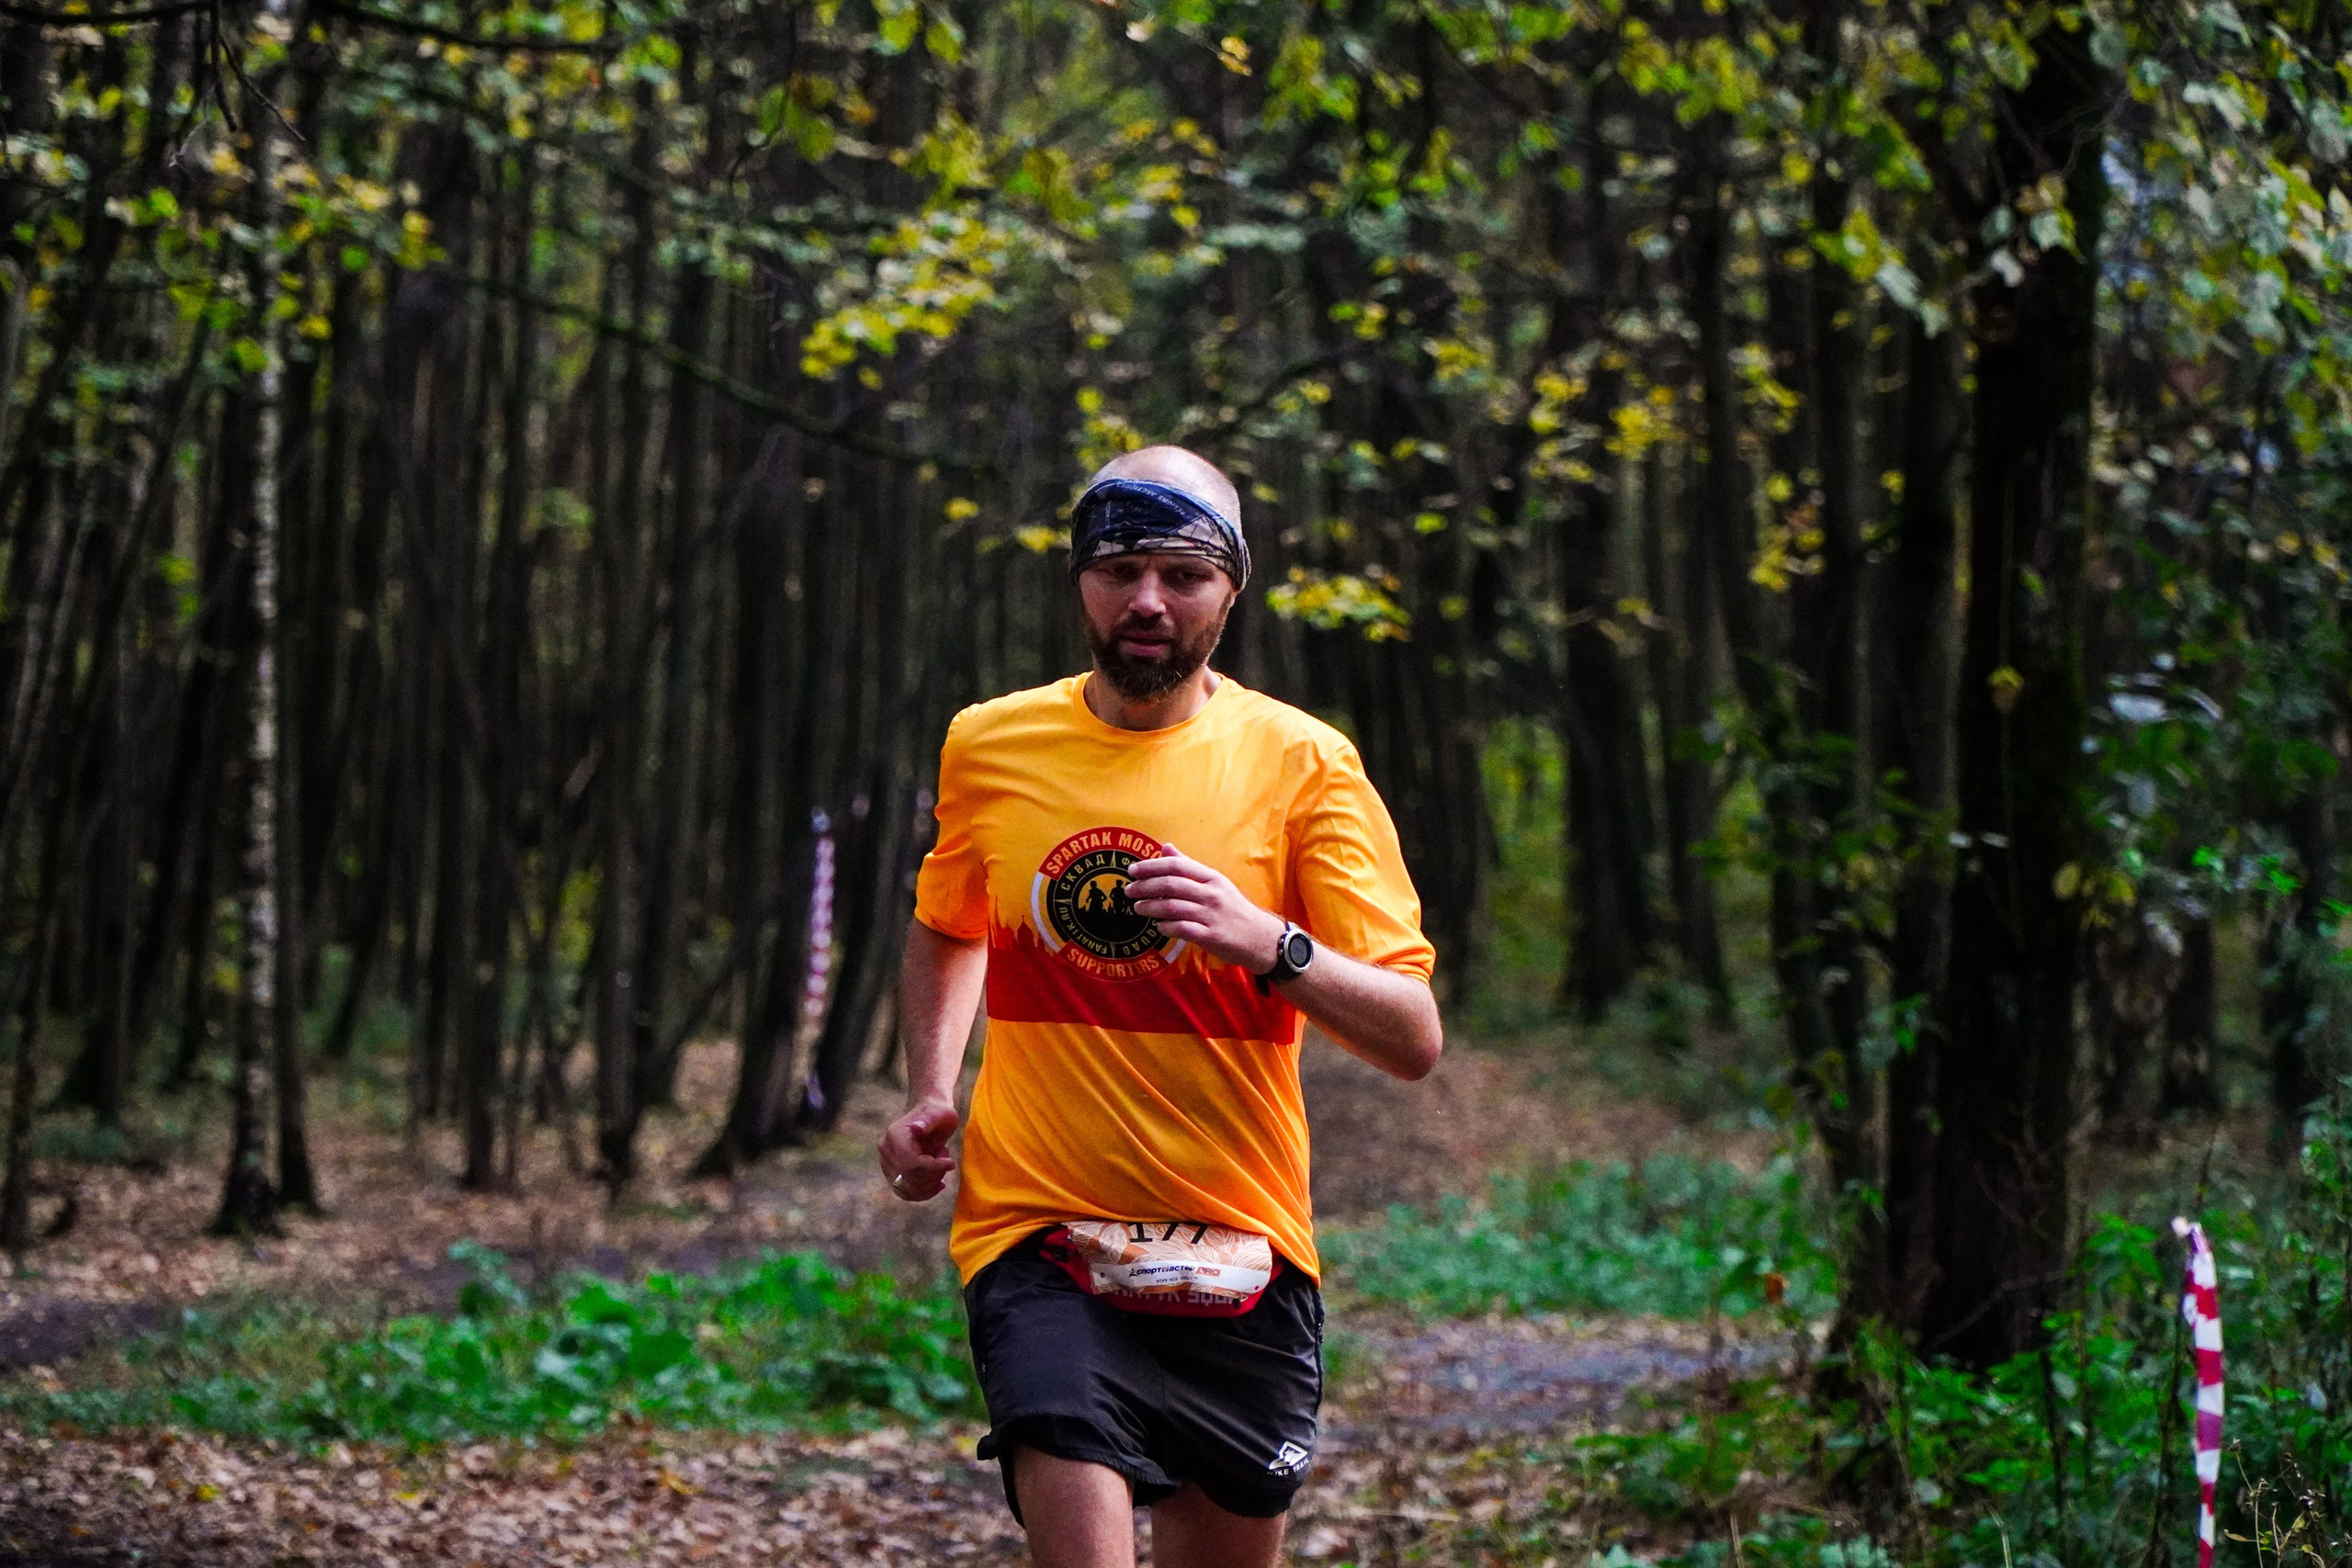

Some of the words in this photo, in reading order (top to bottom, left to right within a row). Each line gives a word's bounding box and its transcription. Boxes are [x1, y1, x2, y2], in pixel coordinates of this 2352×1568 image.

[1046, 831, 1112, 874] SPARTAK
[1061, 853, 1105, 891] СКВАД
[1058, 907, 1108, 954] FANATIK.RU
[1067, 948, 1160, 977] SUPPORTERS
[1196, 1267, 1220, 1276] PRO
